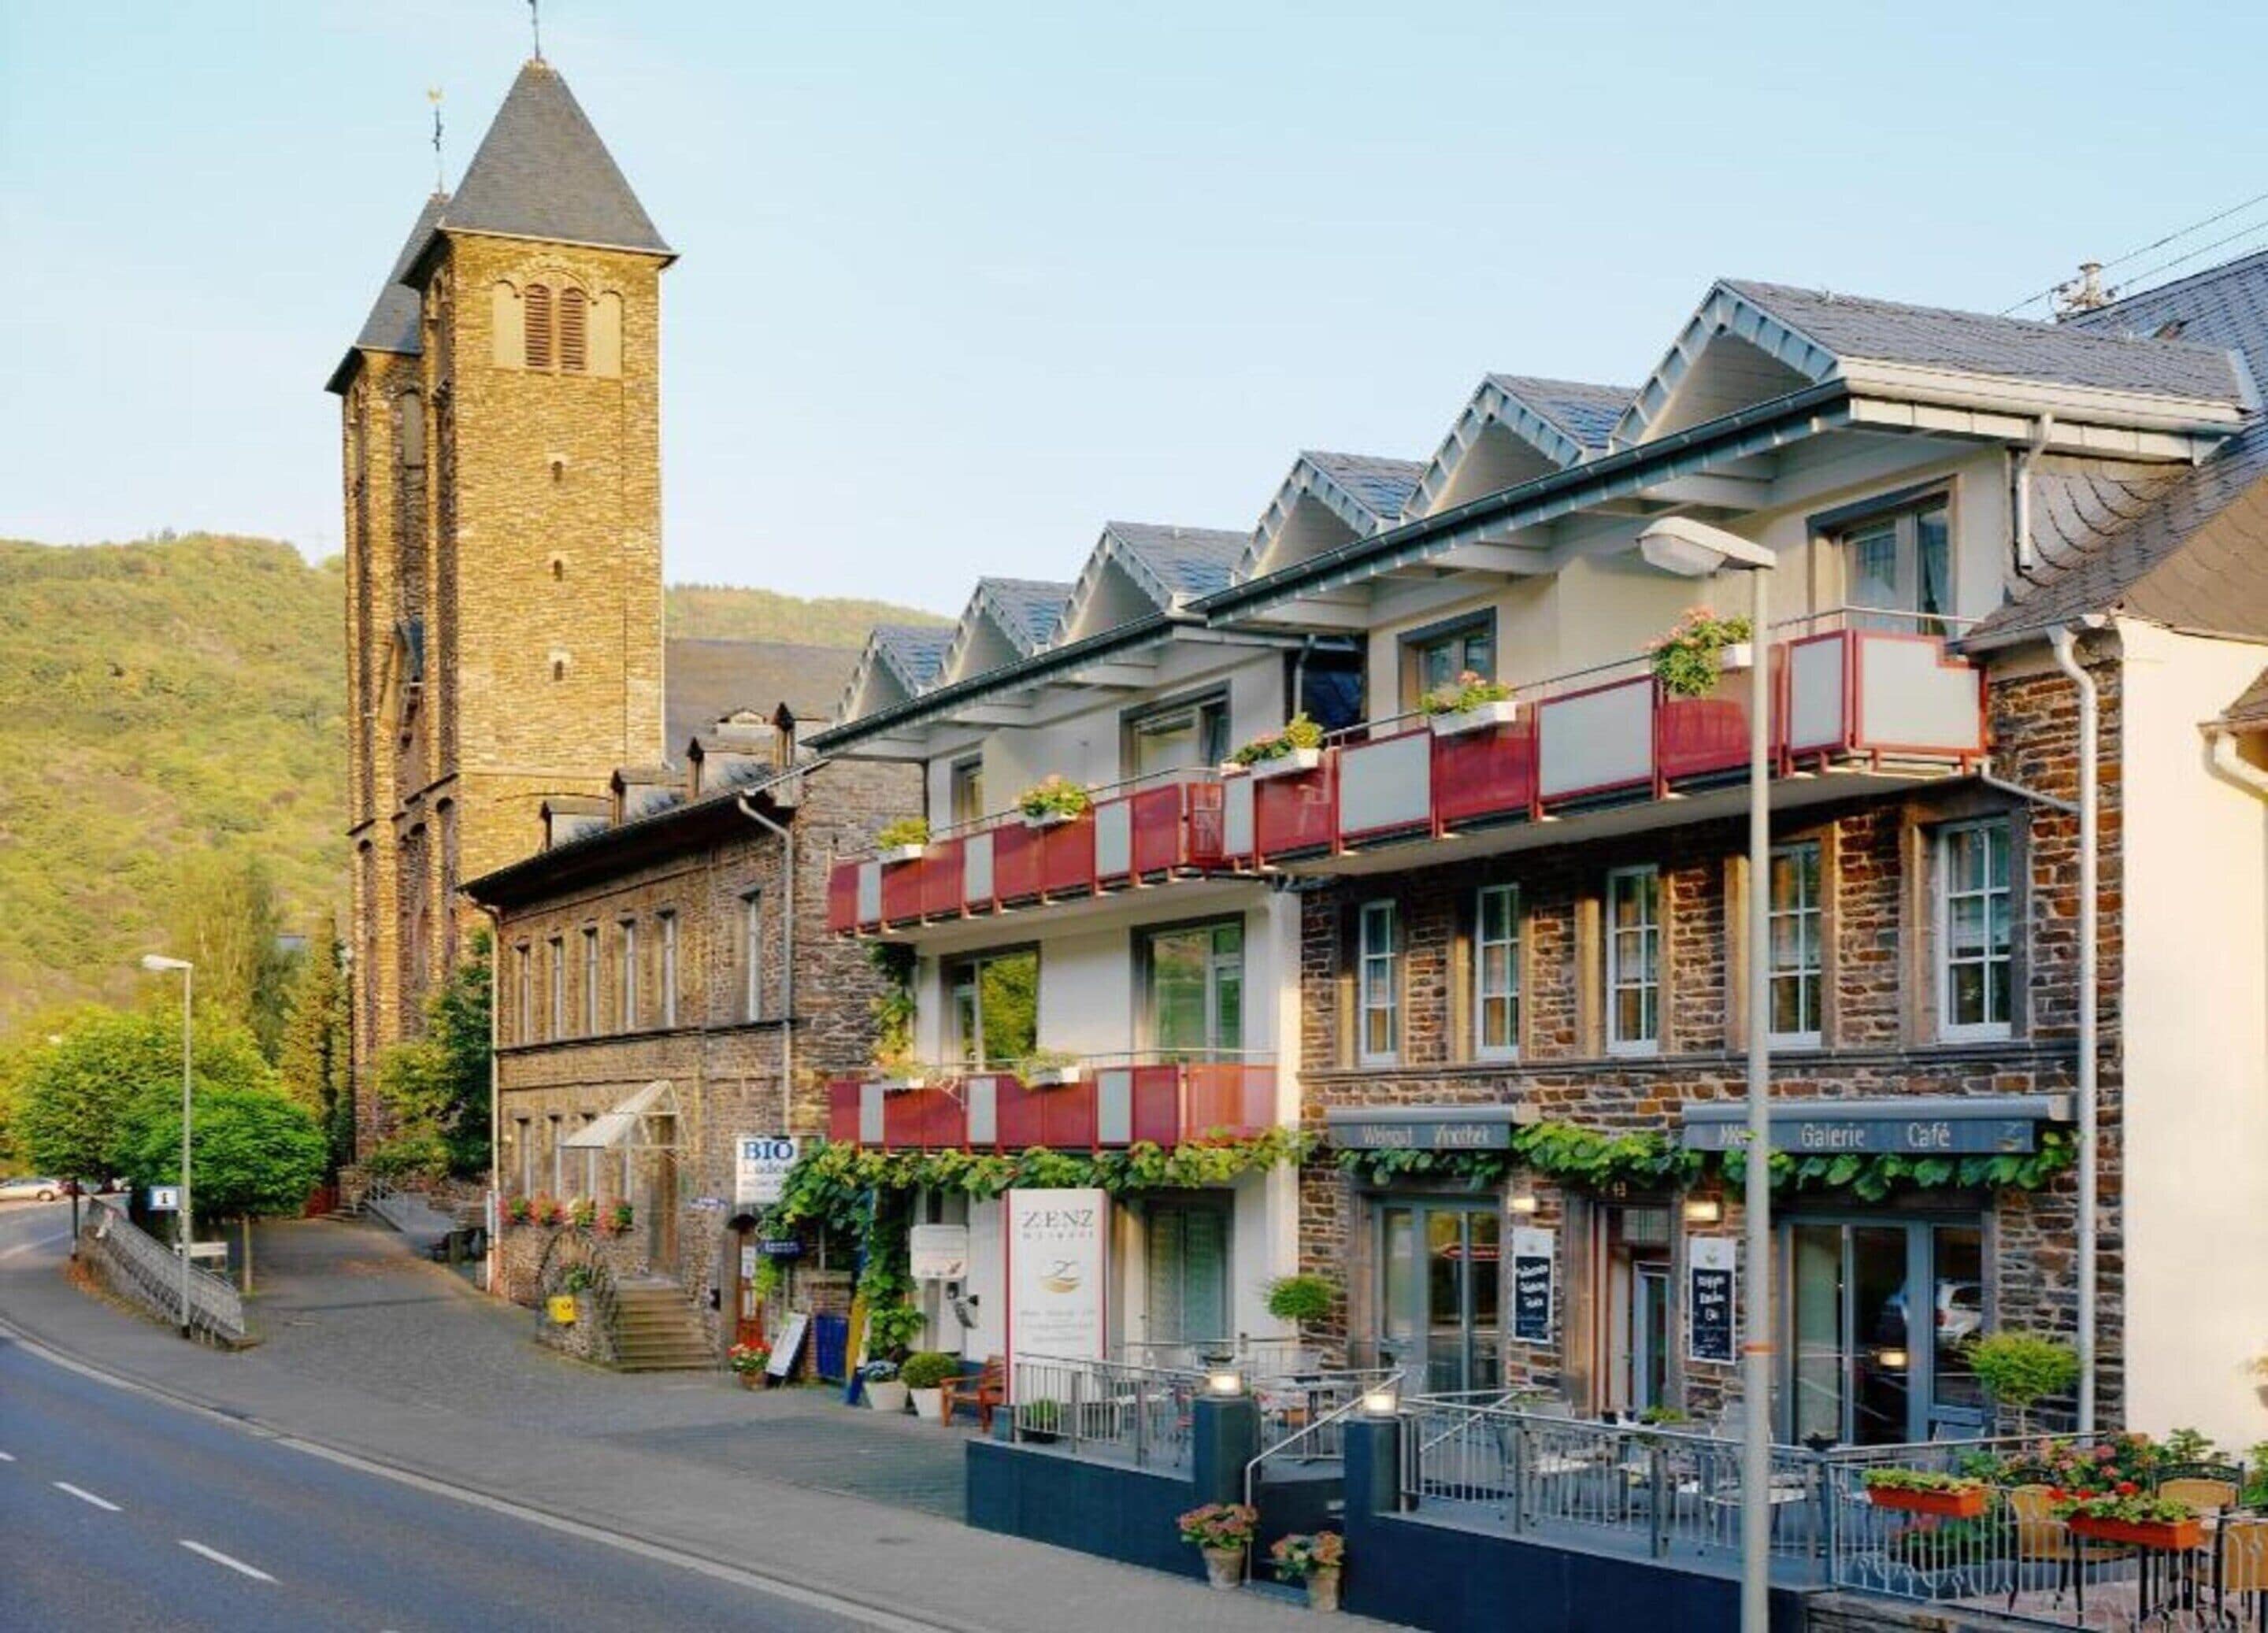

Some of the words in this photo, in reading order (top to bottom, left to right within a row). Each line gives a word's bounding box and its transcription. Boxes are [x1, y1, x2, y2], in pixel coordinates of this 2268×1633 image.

[1802, 1123, 1865, 1147] Galerie
[1908, 1122, 1951, 1147] Café
[743, 1141, 794, 1160] BIO
[1022, 1209, 1094, 1228] ZENZ
